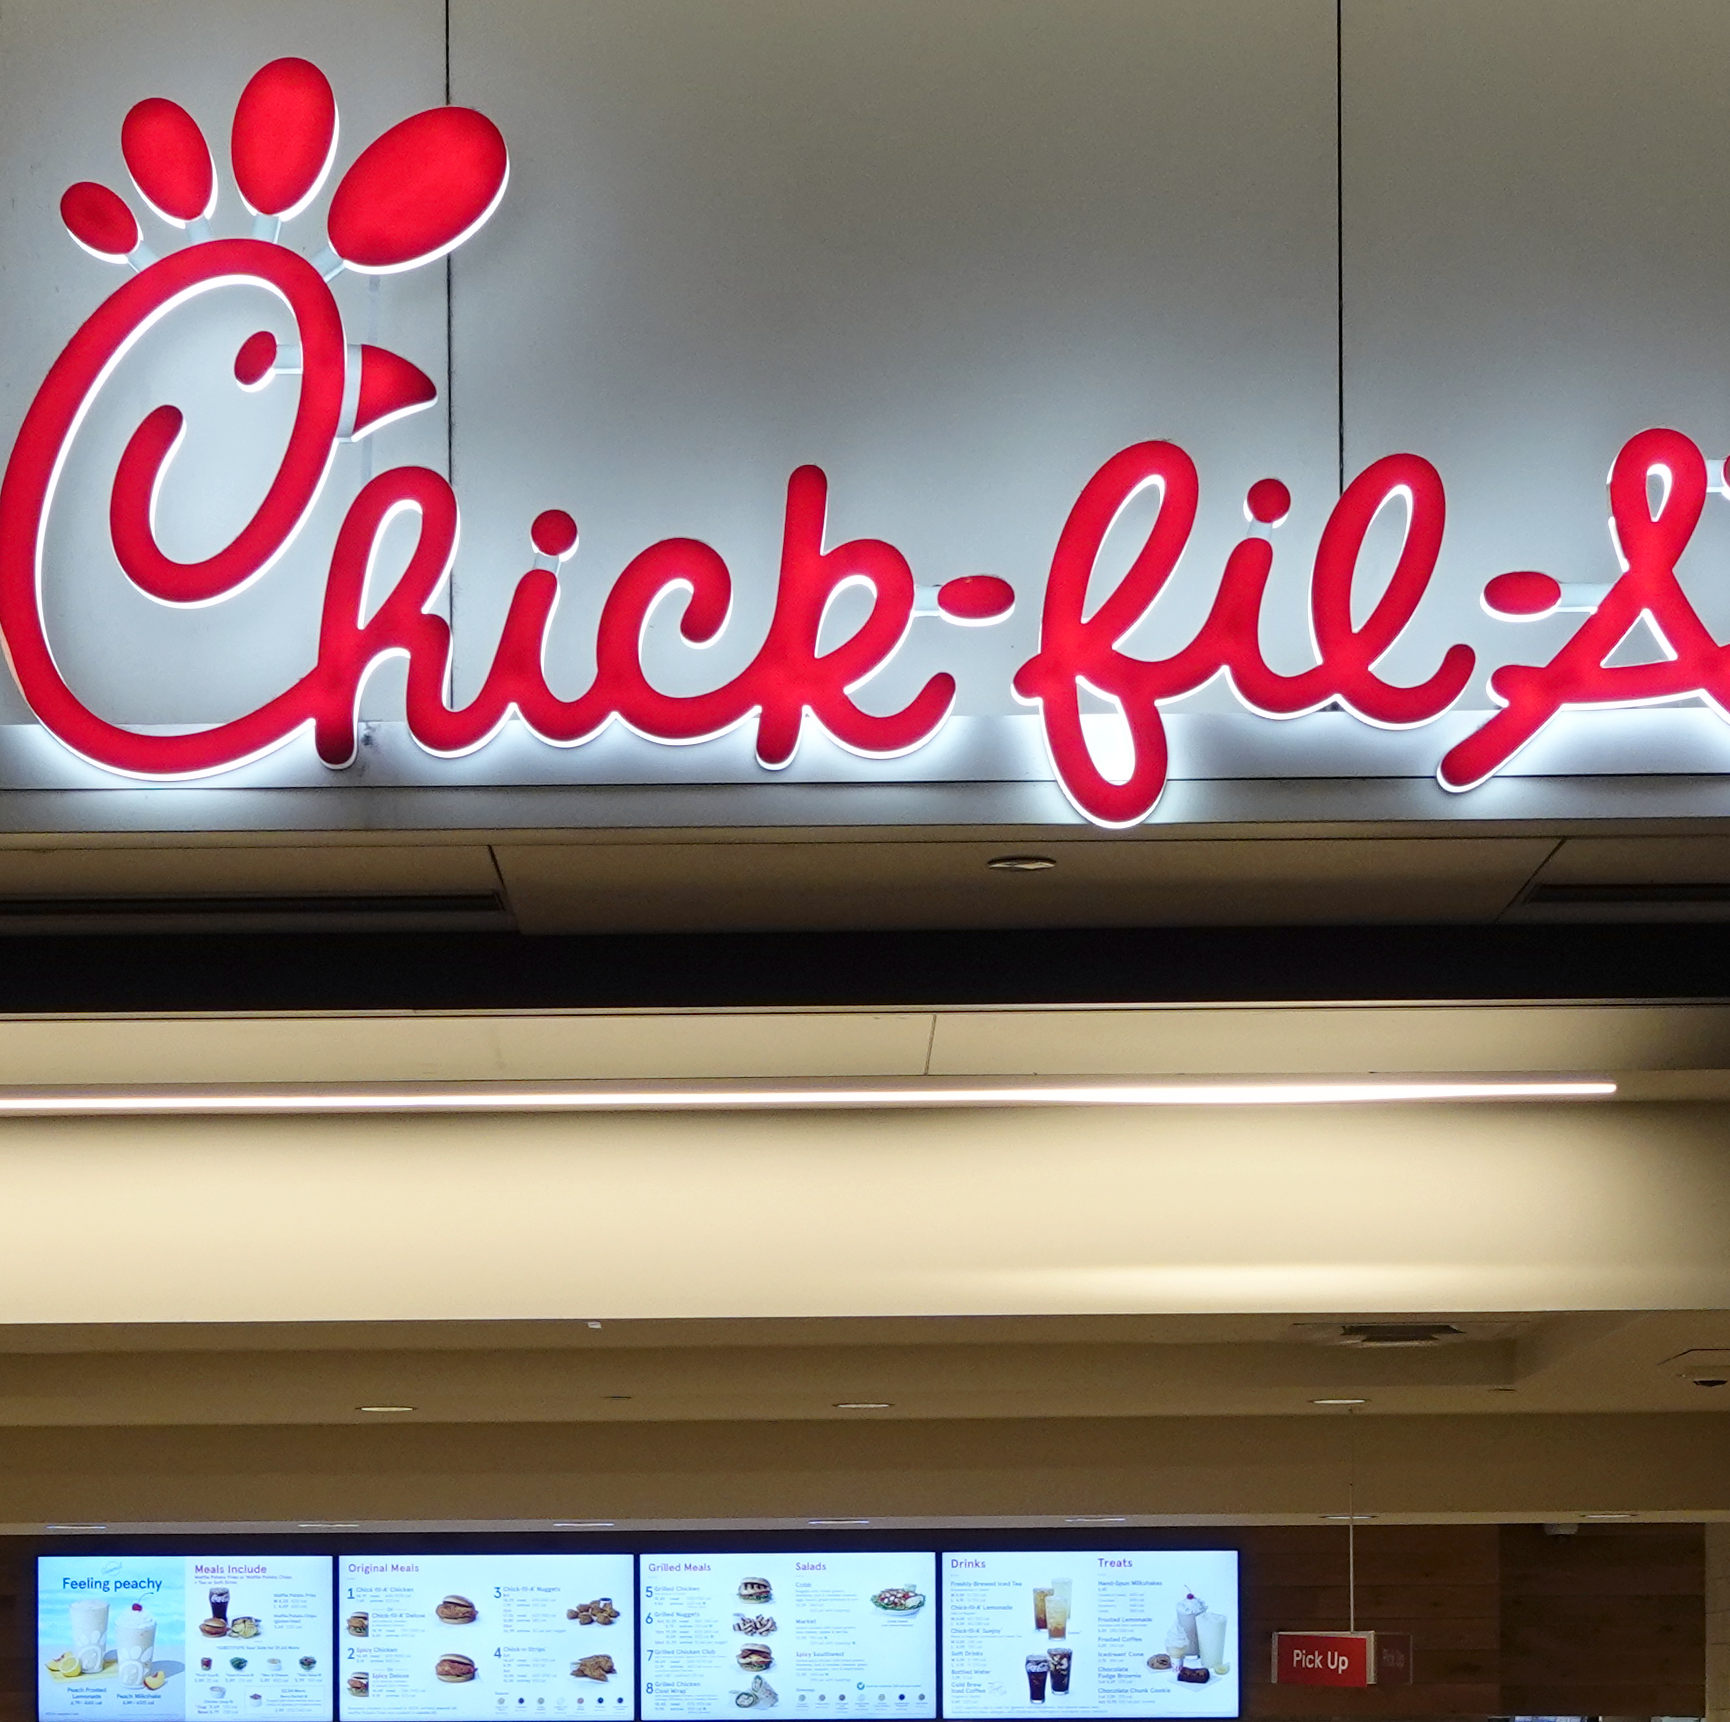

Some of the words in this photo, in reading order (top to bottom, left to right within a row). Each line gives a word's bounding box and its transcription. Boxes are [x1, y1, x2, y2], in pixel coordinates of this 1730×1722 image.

[194, 1564, 224, 1574] Meals
[227, 1564, 267, 1574] Include
[348, 1563, 388, 1575] Original
[391, 1563, 420, 1573] Meals
[648, 1563, 681, 1572] Grilled
[684, 1563, 712, 1572] Meals
[795, 1562, 827, 1571] Salads
[950, 1559, 986, 1569] Drinks
[1098, 1558, 1133, 1568] Treats
[62, 1577, 111, 1592] Feeling
[114, 1577, 163, 1592] peachy
[347, 1588, 355, 1599] 1
[493, 1587, 502, 1599] 3
[645, 1586, 654, 1598] 5
[645, 1612, 653, 1624] 6
[347, 1648, 355, 1659] 2
[493, 1647, 502, 1659] 4
[646, 1649, 654, 1661] 7
[1292, 1649, 1323, 1670] Pick
[1326, 1650, 1350, 1675] Up
[645, 1682, 654, 1694] 8
